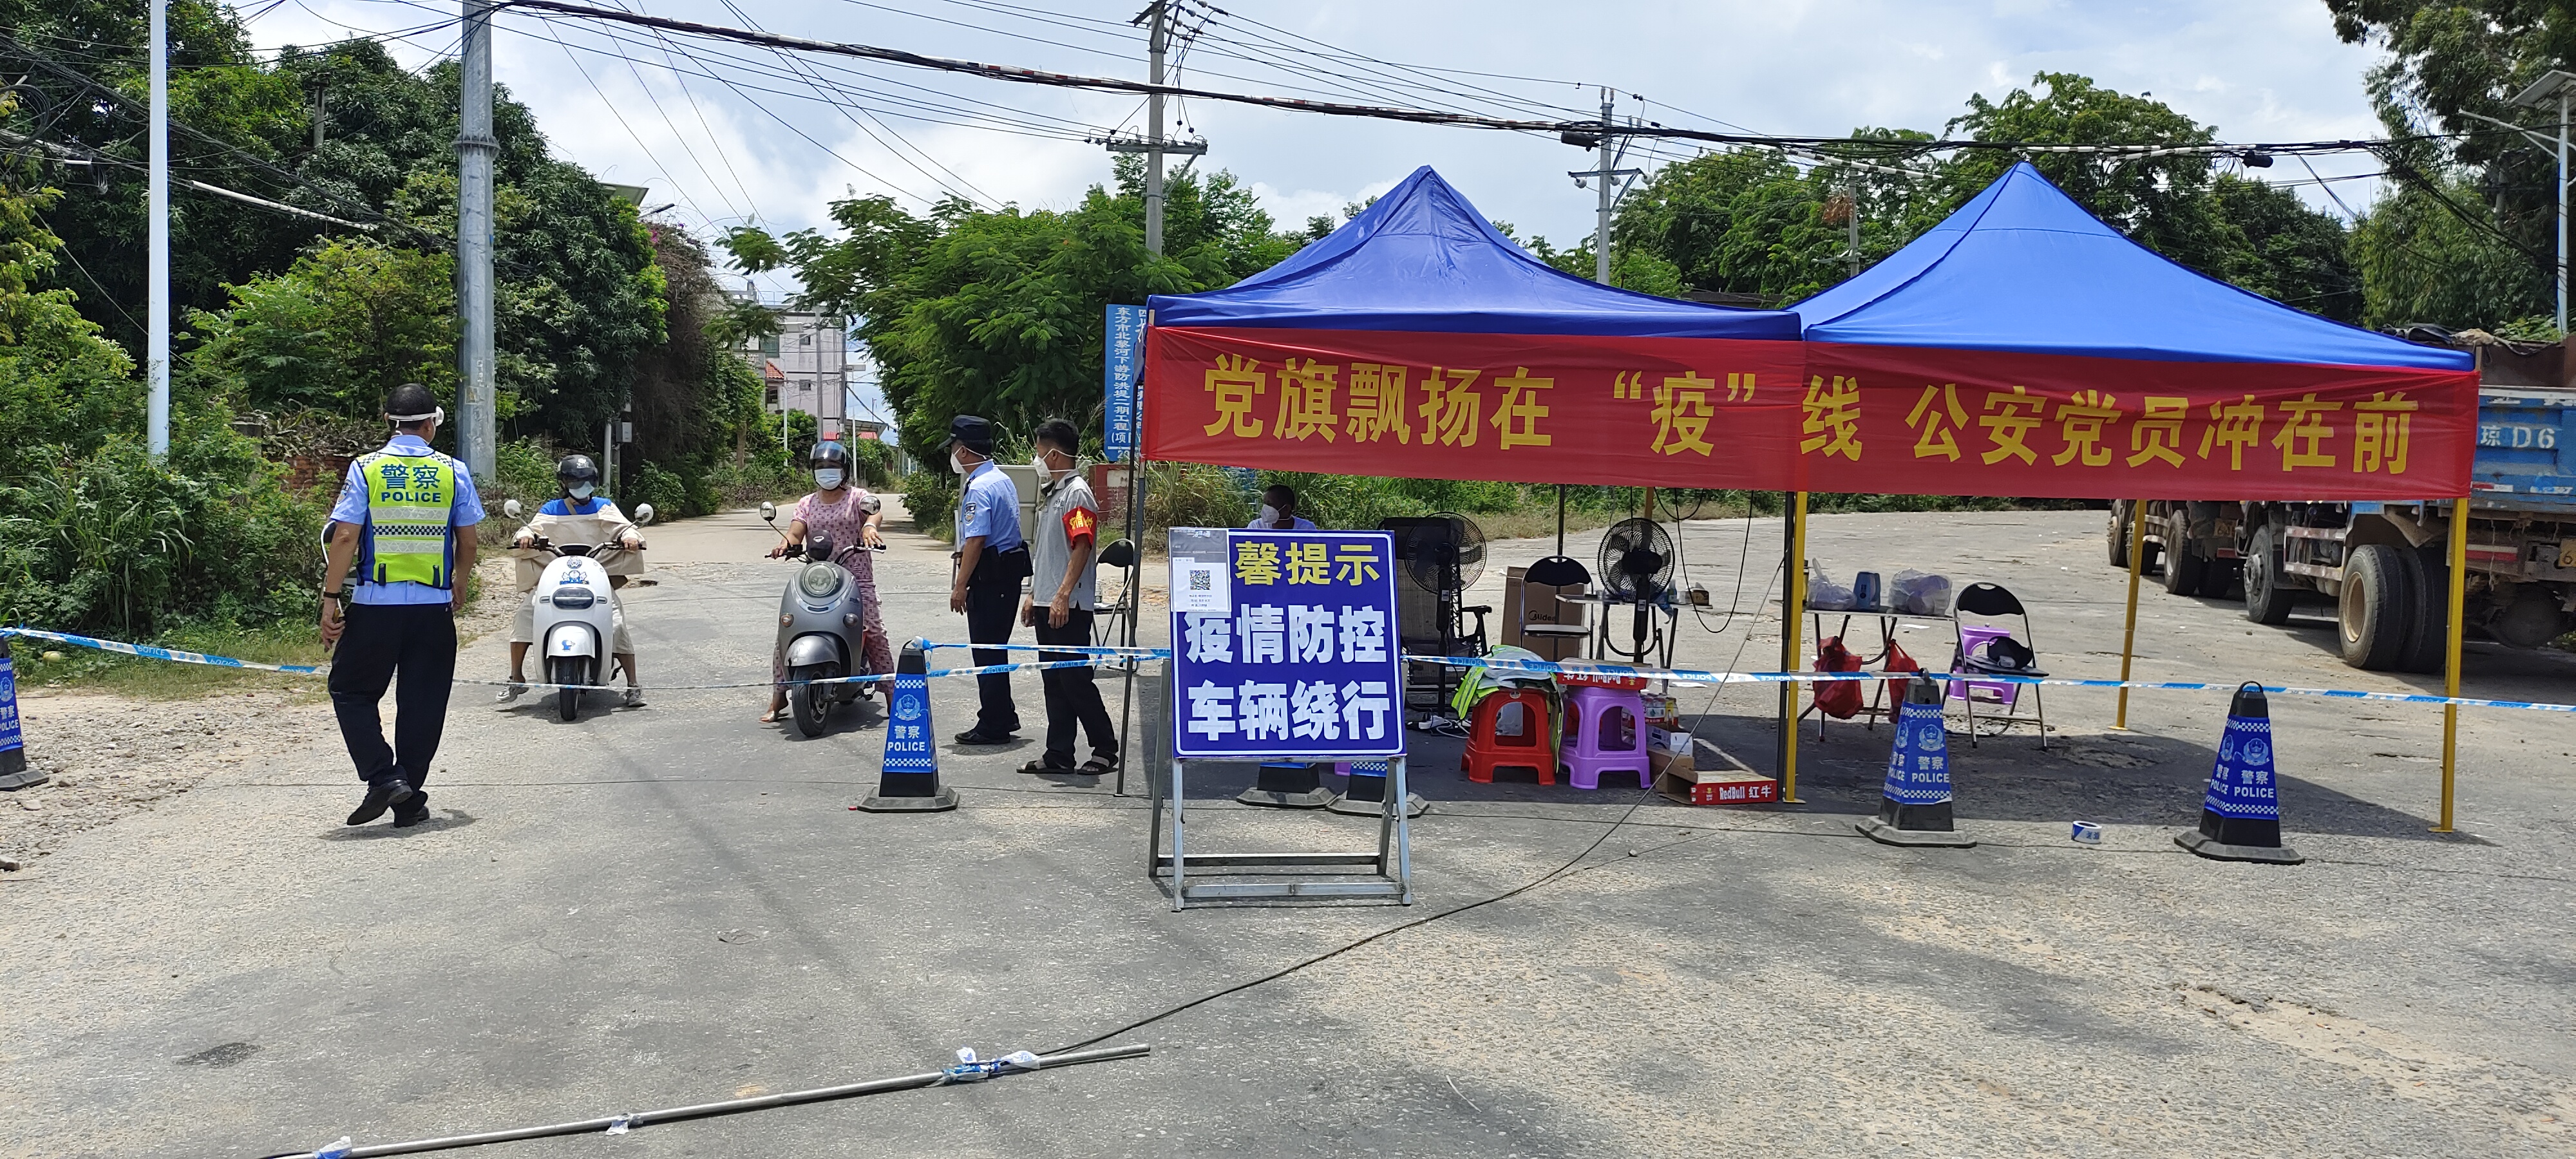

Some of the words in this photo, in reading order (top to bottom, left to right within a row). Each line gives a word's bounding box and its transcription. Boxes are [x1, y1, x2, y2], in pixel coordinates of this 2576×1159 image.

[381, 464, 441, 490] 警察
[381, 491, 442, 503] POLICE
[1231, 540, 1380, 586] 馨提示
[1184, 603, 1387, 664] 疫情防控
[1188, 679, 1391, 741] 车辆绕行
[894, 725, 920, 739] 警察
[887, 742, 925, 751] POLICE
[1917, 756, 1944, 771] 警察
[1911, 773, 1950, 783] POLICE
[2241, 769, 2269, 785] 警察
[1719, 786, 1745, 800] RedBull
[1748, 784, 1772, 798] 红牛
[2234, 786, 2274, 798] POLICE
